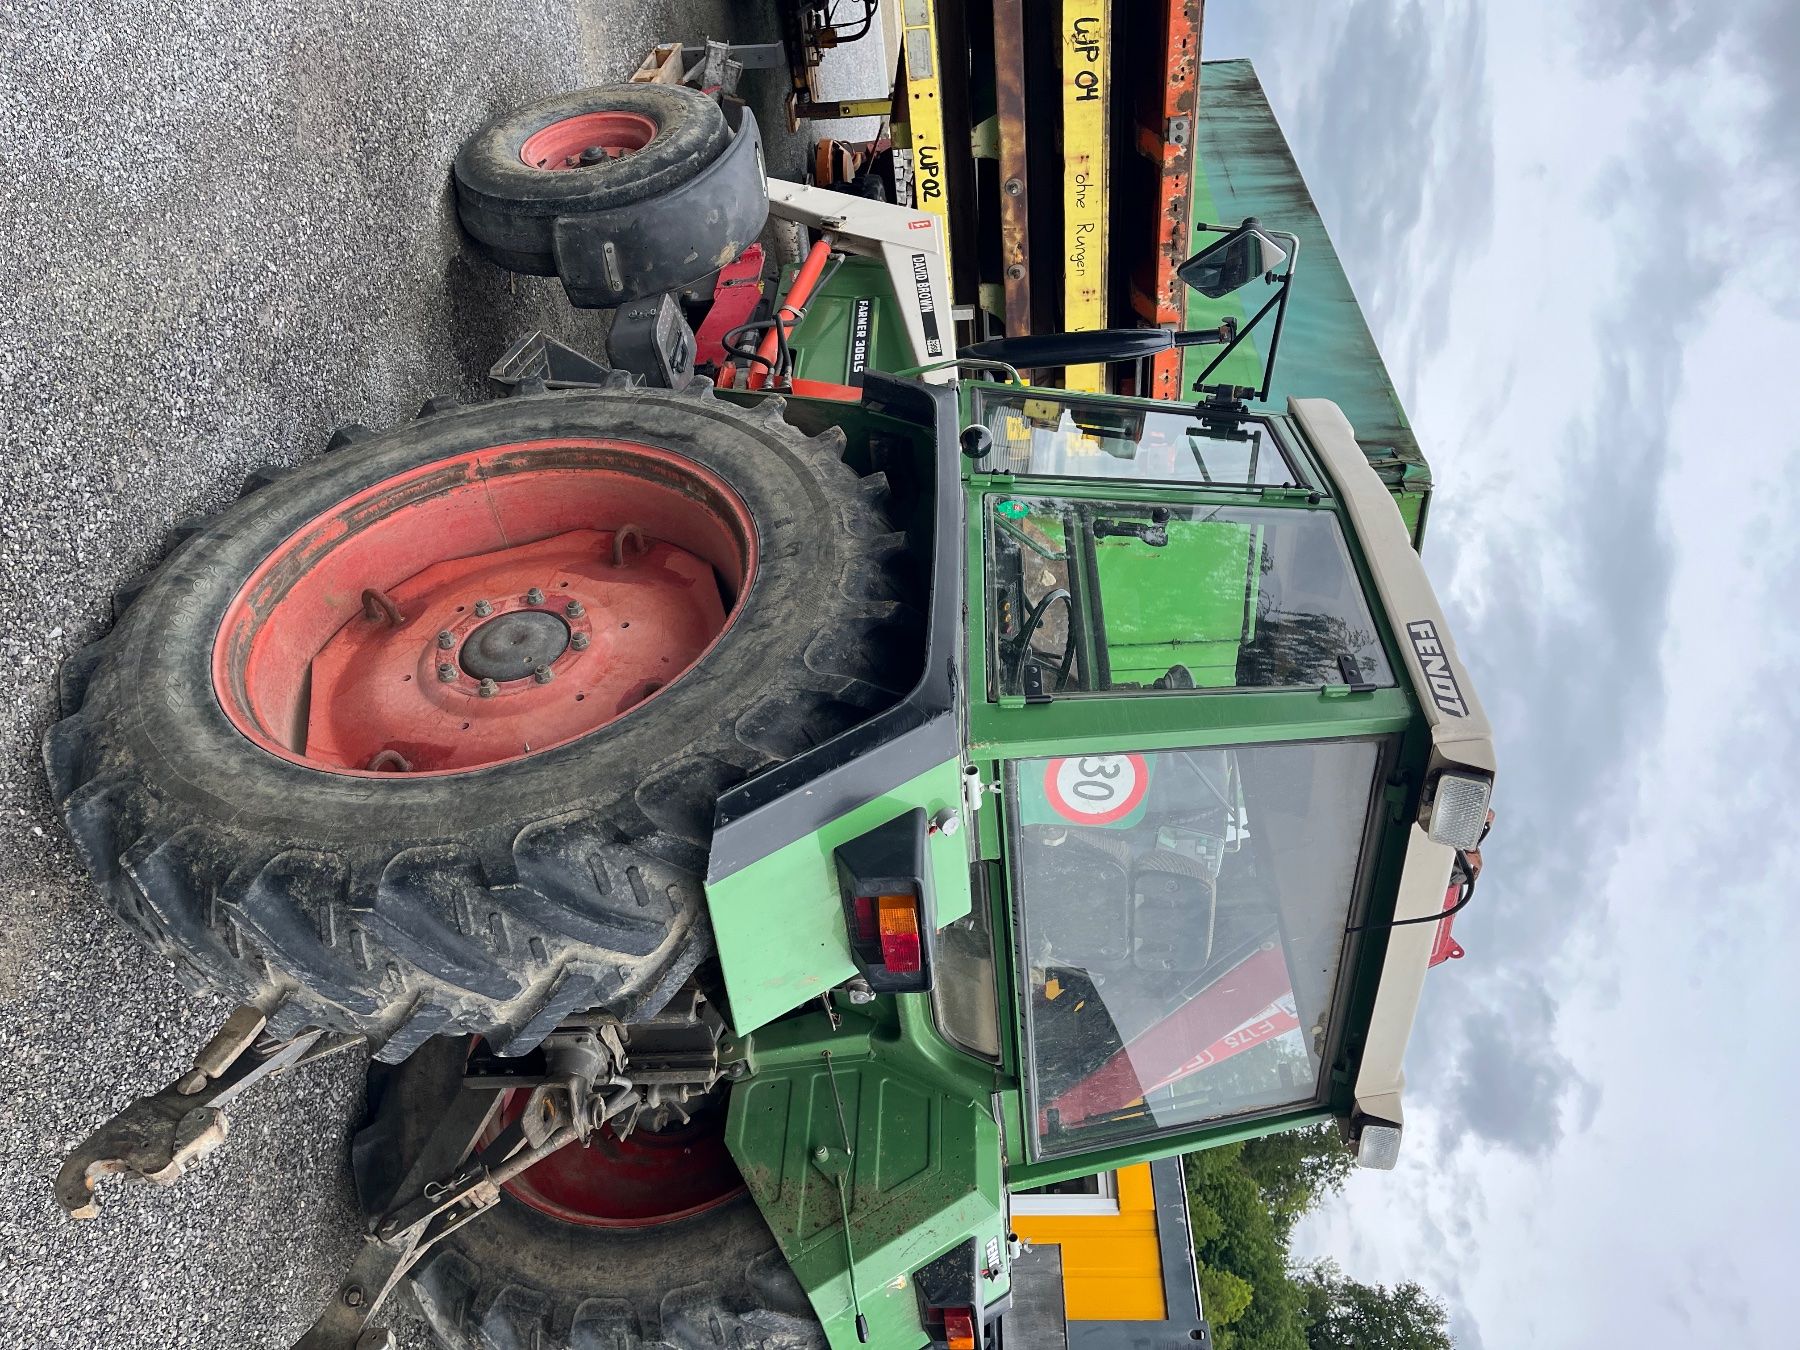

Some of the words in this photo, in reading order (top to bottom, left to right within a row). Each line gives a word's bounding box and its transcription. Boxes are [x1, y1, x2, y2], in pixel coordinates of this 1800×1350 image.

[1073, 18, 1100, 62] WP
[1074, 70, 1099, 101] 04
[1074, 174, 1094, 208] ohne
[912, 256, 927, 280] DAVID
[1067, 223, 1094, 277] Rungen
[916, 282, 934, 313] BROWN
[856, 300, 868, 338] FARMER
[852, 340, 866, 373] 306LS
[1409, 622, 1467, 718] FENDT
[1072, 756, 1121, 801] 30
